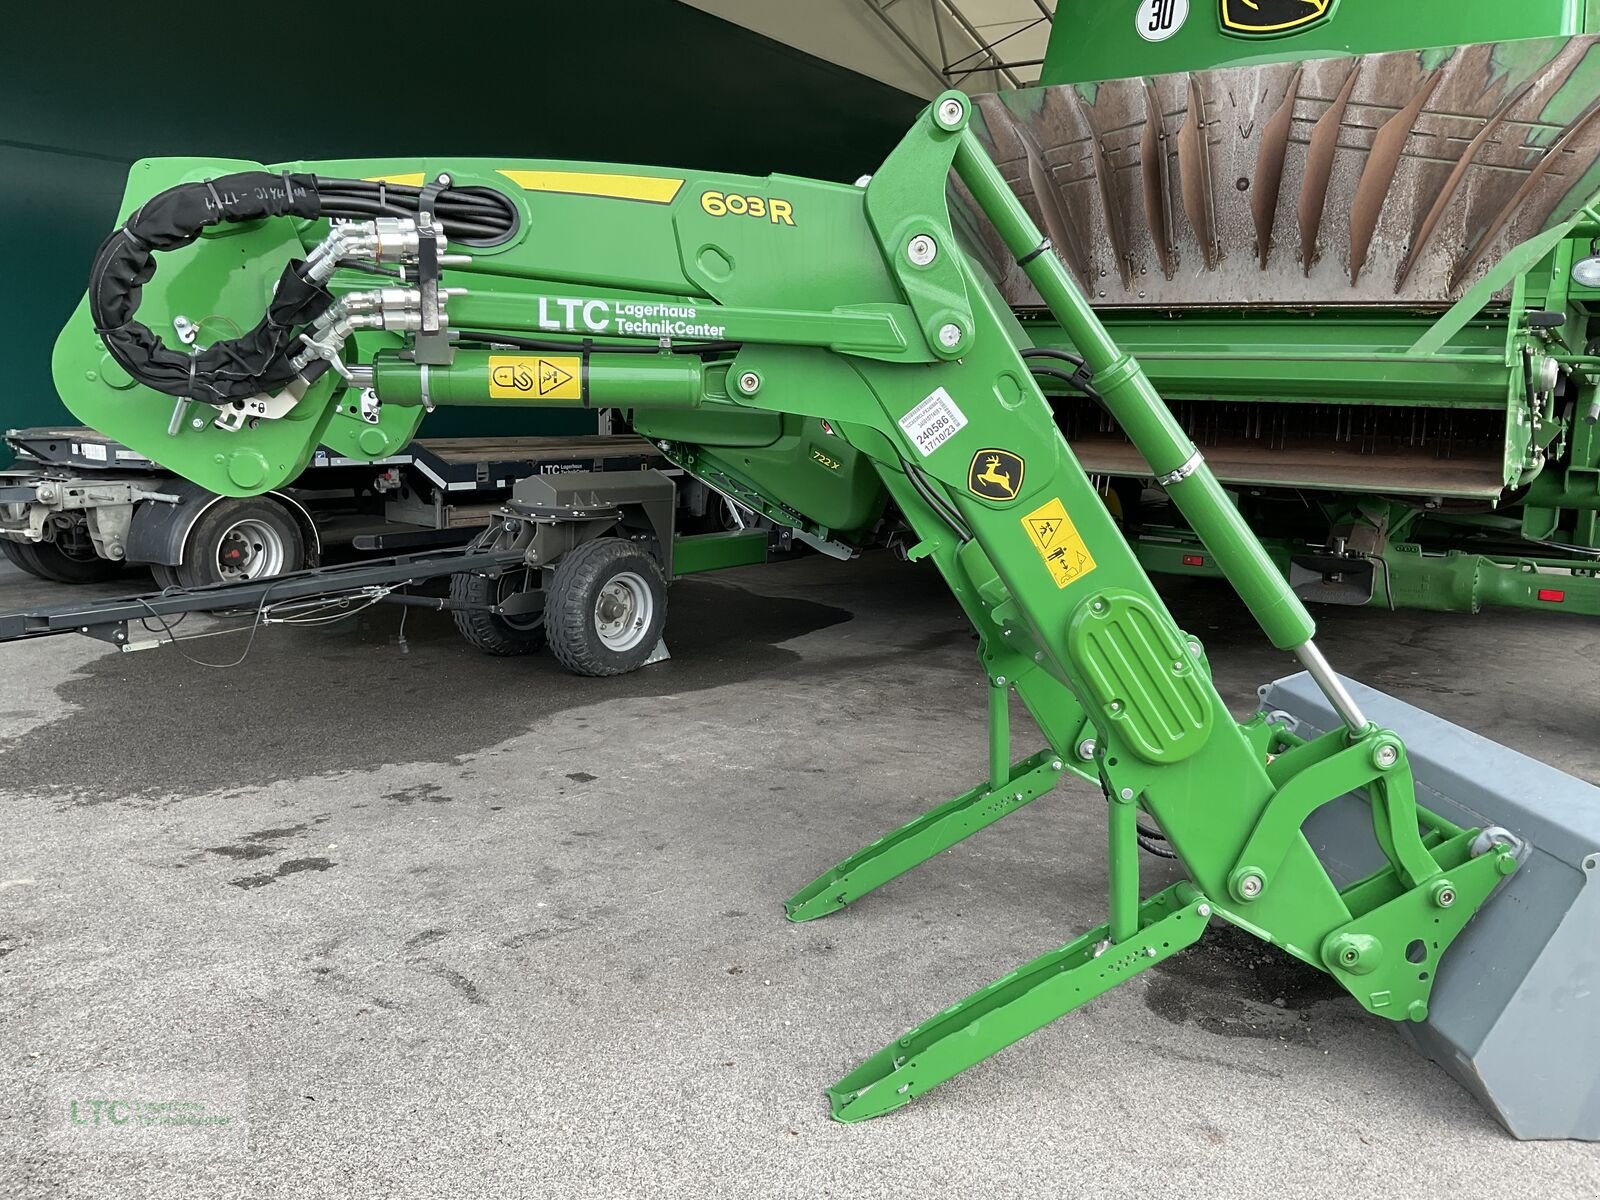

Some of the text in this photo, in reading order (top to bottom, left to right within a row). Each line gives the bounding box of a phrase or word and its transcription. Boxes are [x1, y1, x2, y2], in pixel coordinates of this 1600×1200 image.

[1148, 0, 1175, 32] 30
[701, 190, 798, 227] 603R
[538, 297, 610, 331] LTC
[615, 302, 697, 319] Lagerhaus
[615, 318, 726, 337] TechnikCenter
[916, 414, 950, 445] 240586
[924, 424, 956, 452] 17/10/23
[540, 464, 560, 475] LTC
[813, 450, 841, 470] 722 X
